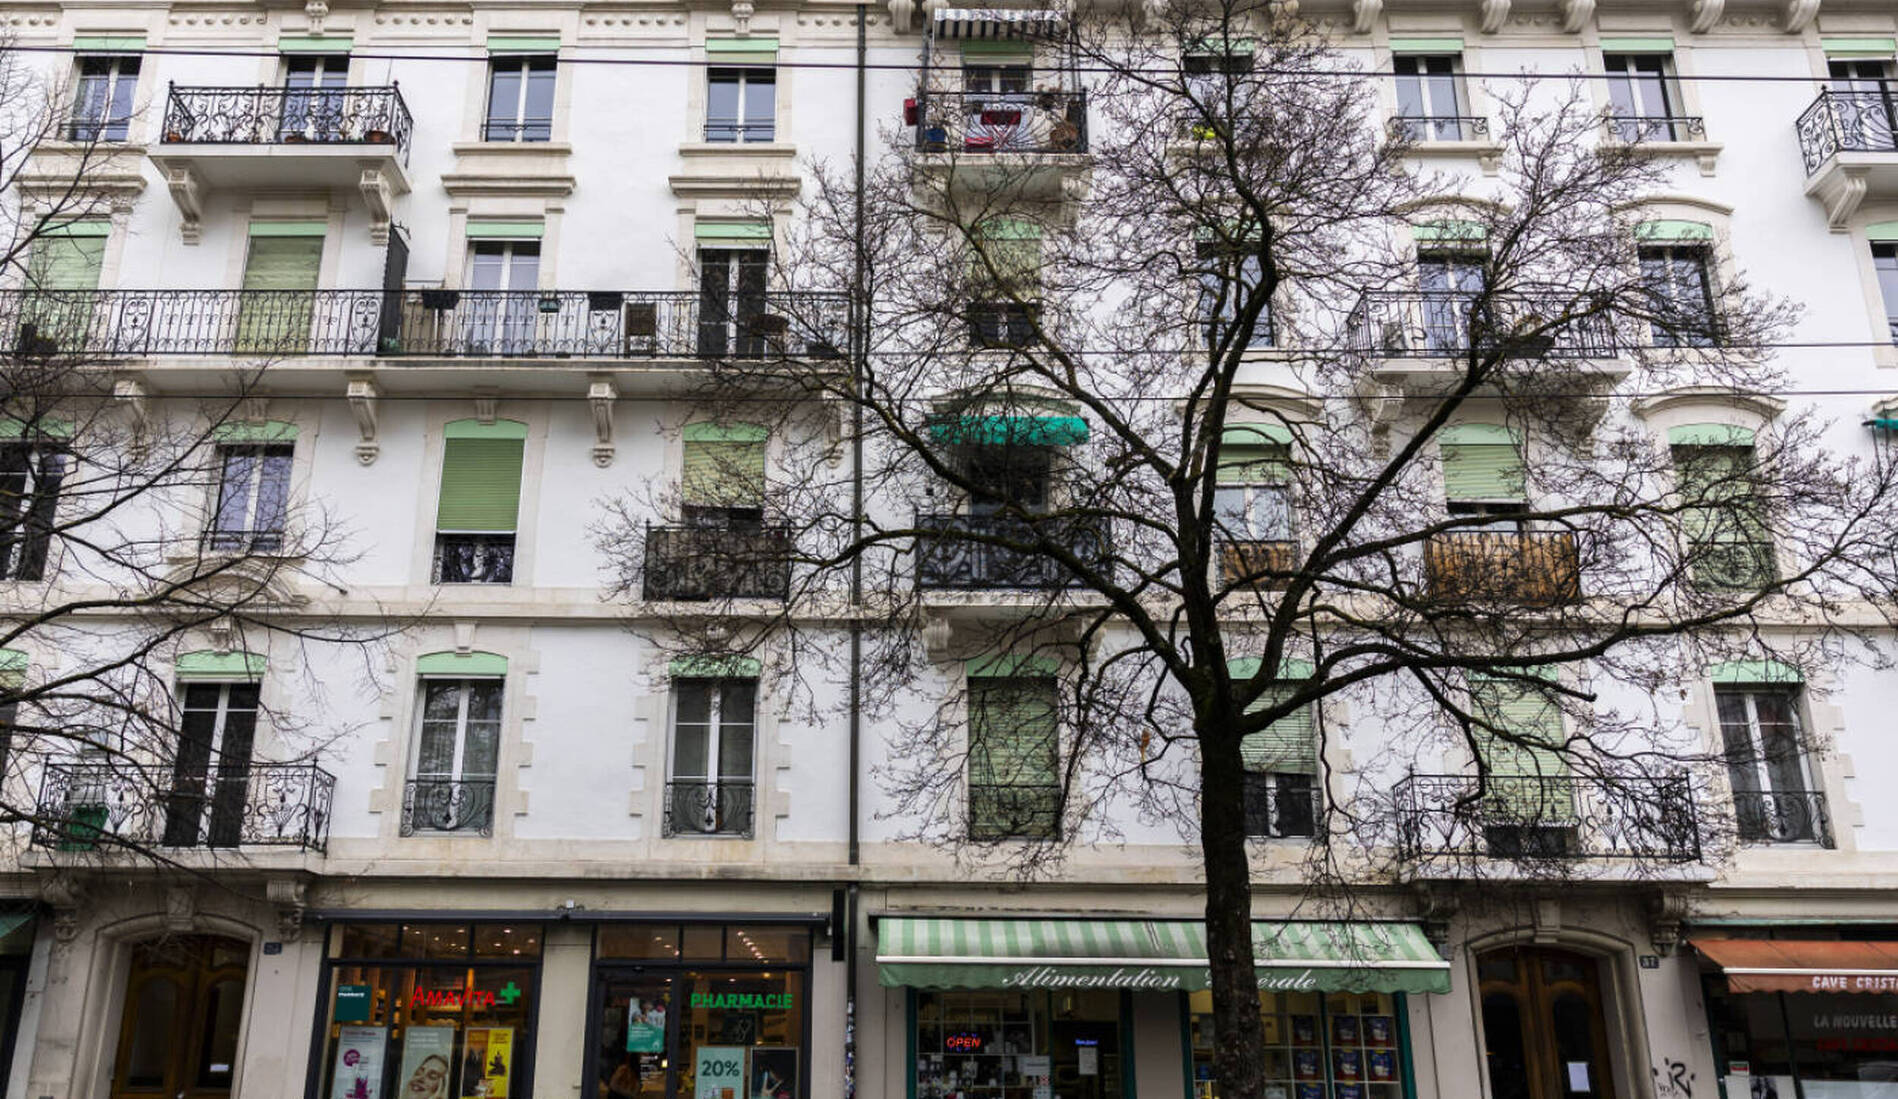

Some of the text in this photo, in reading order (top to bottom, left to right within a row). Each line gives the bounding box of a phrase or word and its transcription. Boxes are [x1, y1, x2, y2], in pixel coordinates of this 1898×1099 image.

[1001, 966, 1317, 990] Alimentation érale
[1812, 976, 1848, 989] CAVE
[690, 993, 793, 1009] PHARMACIE
[1814, 1015, 1897, 1029] LA NOUVELLE
[946, 1036, 981, 1048] OPEN
[702, 1060, 740, 1077] 20%
